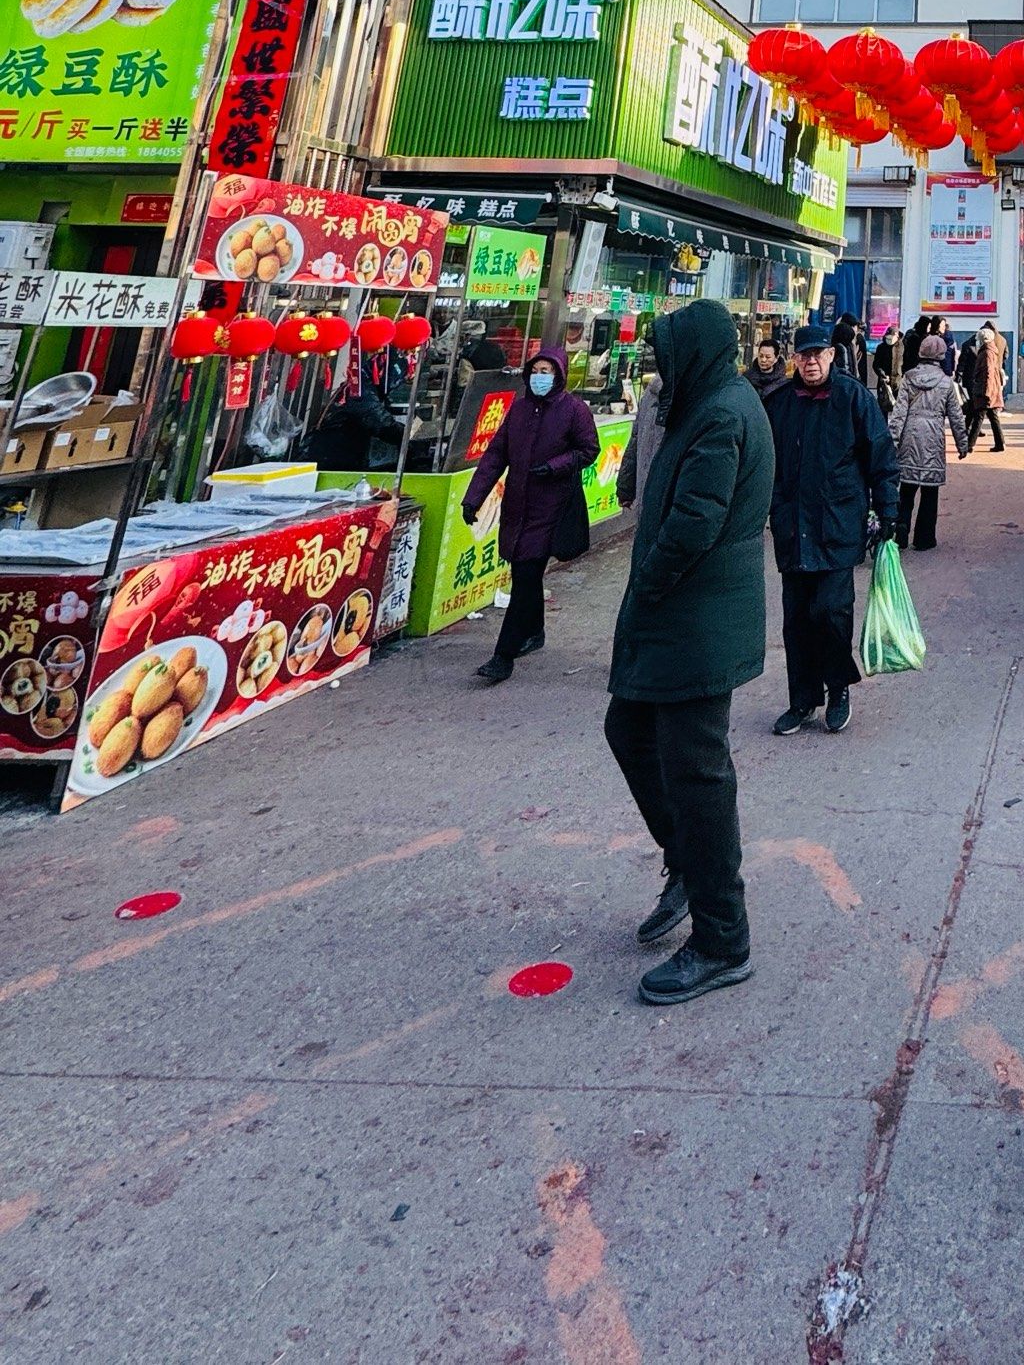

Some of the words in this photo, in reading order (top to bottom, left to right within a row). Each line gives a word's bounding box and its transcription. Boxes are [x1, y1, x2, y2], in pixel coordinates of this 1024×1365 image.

[0, 44, 169, 99] 绿豆酥
[499, 76, 595, 121] 糕点
[672, 25, 788, 185] 酥忆味
[223, 178, 247, 196] 福
[473, 246, 518, 277] 绿豆酥
[54, 277, 146, 321] 米花酥
[125, 568, 162, 606] 福
